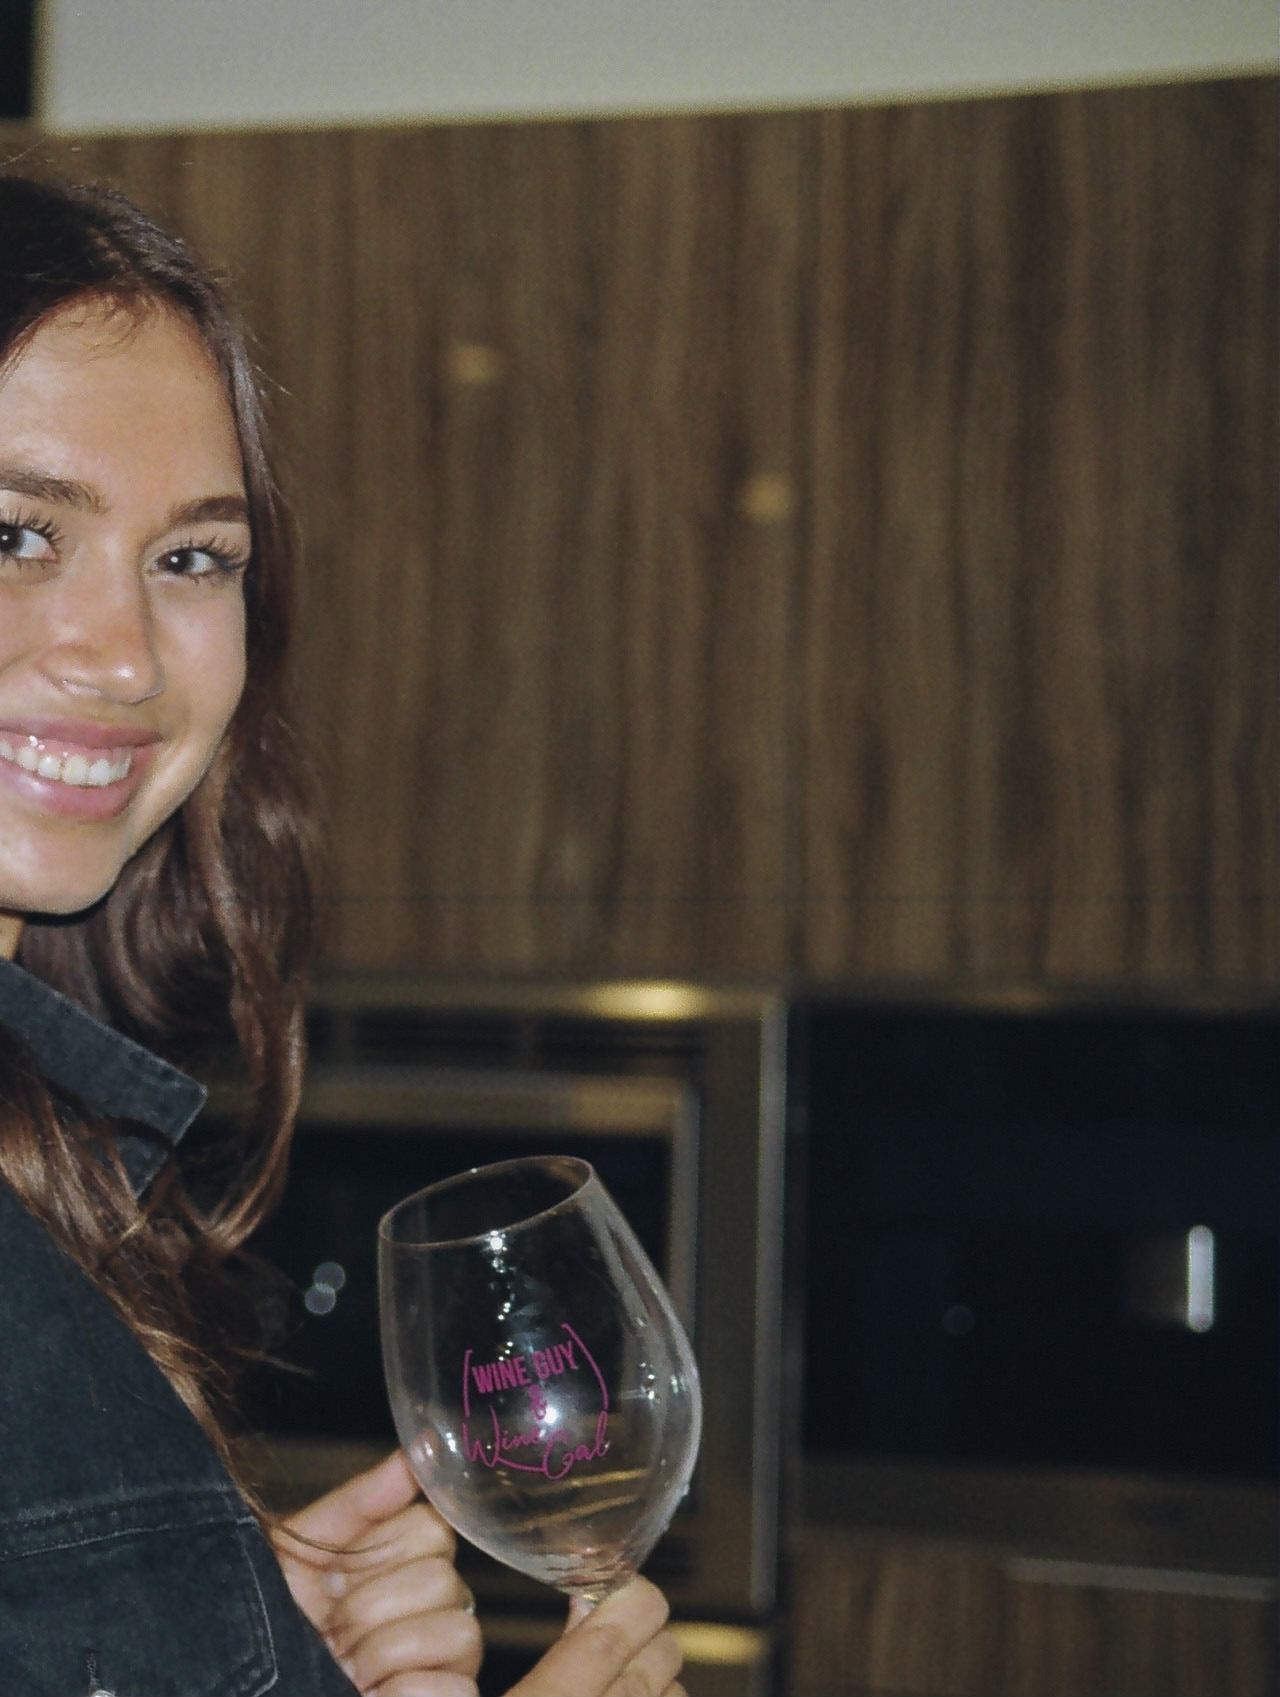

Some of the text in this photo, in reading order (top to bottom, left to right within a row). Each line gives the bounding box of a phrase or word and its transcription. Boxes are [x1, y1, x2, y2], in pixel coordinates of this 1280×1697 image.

[472, 1341, 577, 1394] WINE GUY
[543, 1411, 610, 1480] Gal
